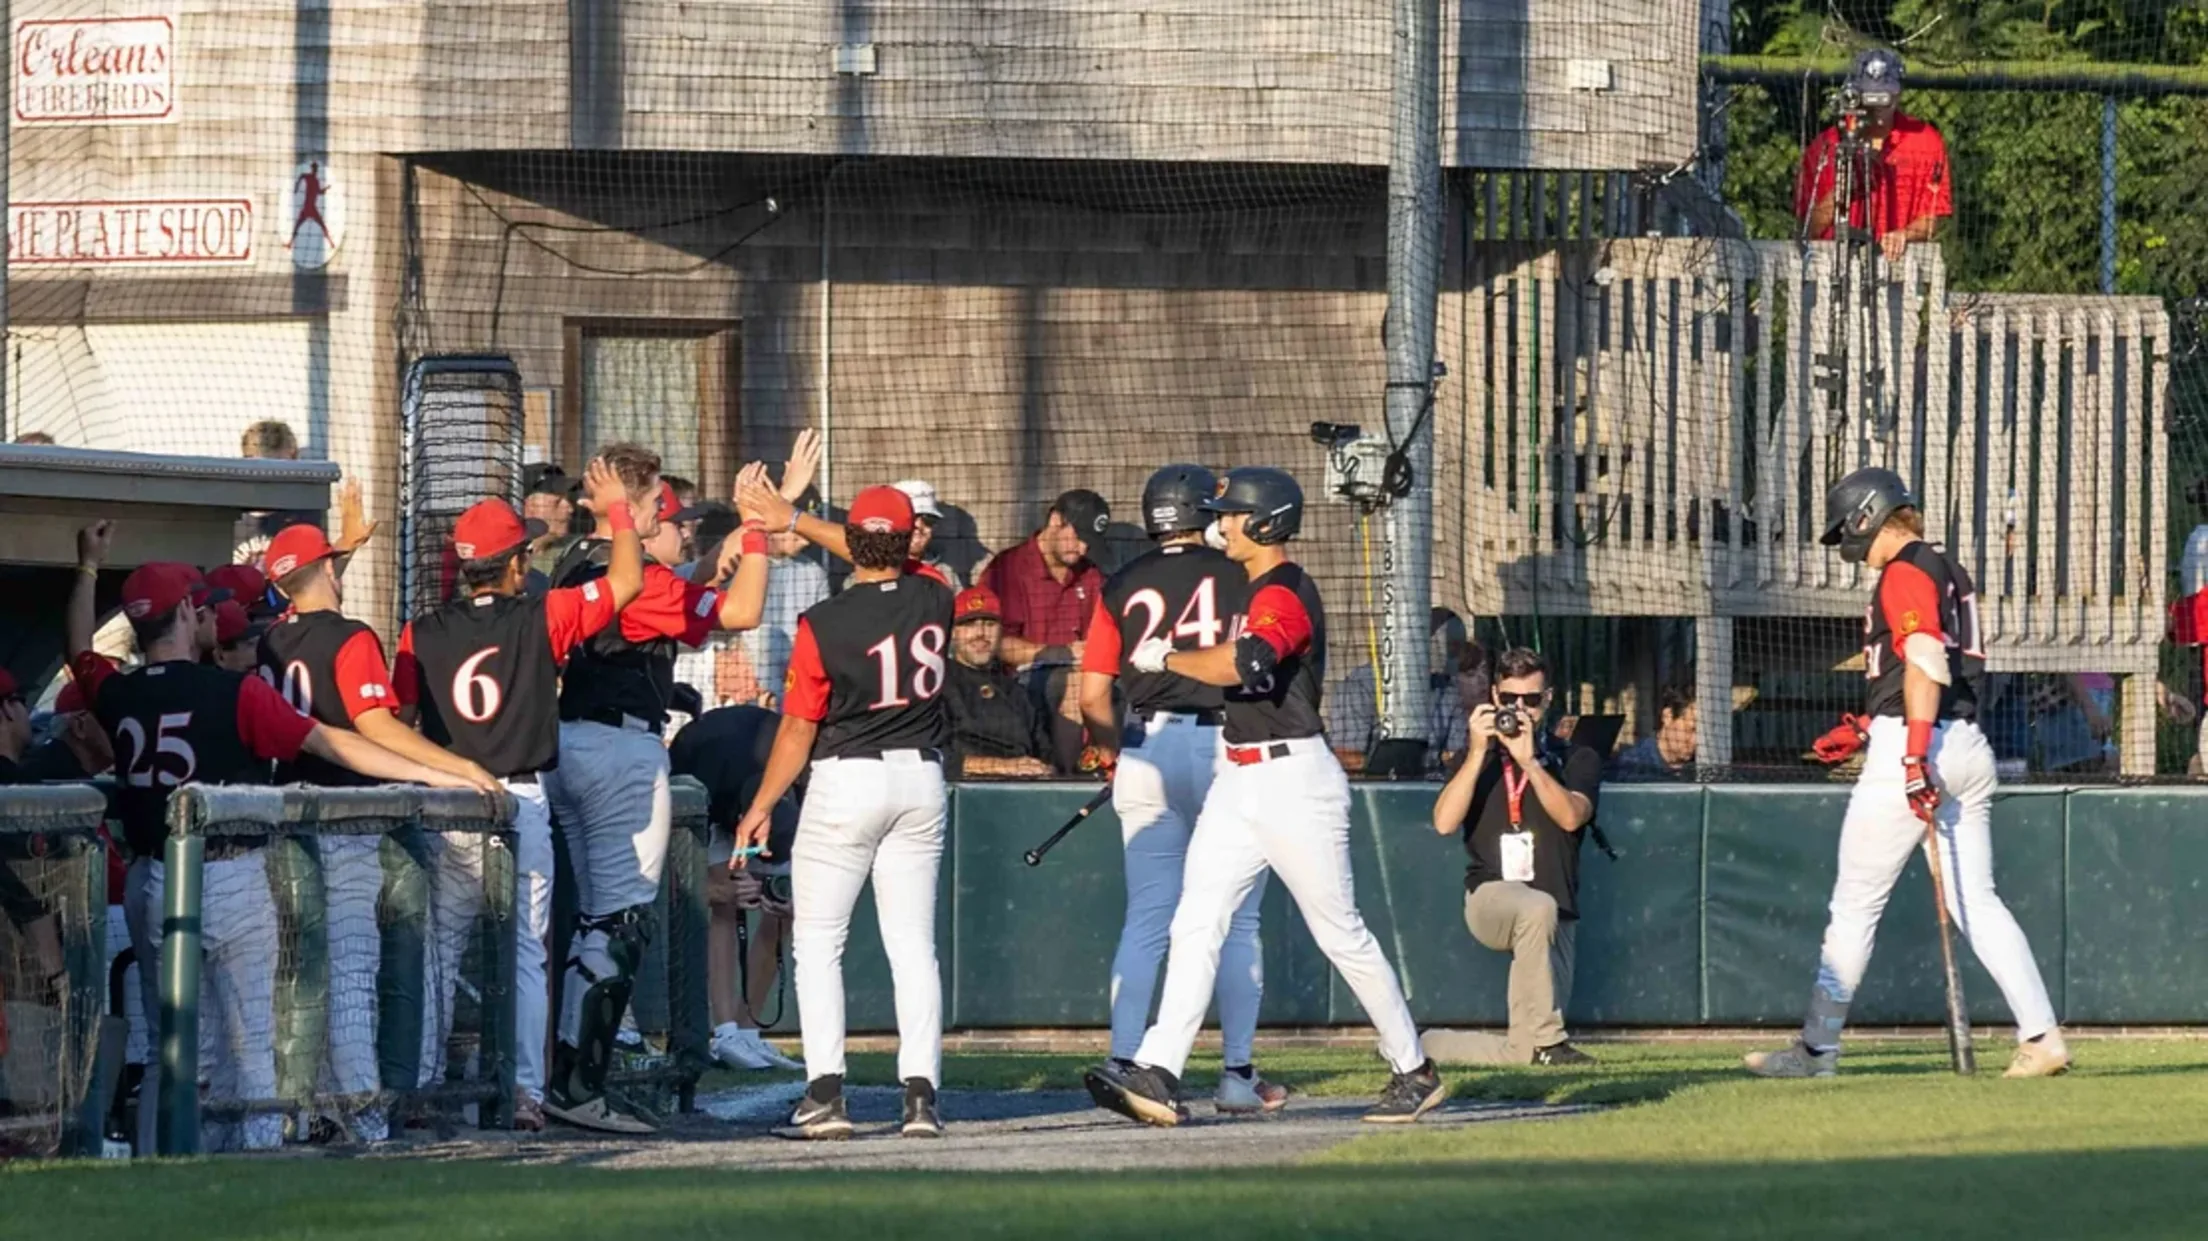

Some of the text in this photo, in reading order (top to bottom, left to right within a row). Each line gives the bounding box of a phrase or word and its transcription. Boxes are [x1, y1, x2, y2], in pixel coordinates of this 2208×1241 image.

[21, 28, 165, 76] Orleans
[24, 82, 165, 113] FIREBIRDS
[55, 209, 150, 257] PLATE
[159, 207, 244, 256] SHOP
[1122, 576, 1222, 664] 24
[453, 645, 501, 723] 6
[865, 623, 946, 711] 18
[116, 710, 196, 788] 25
